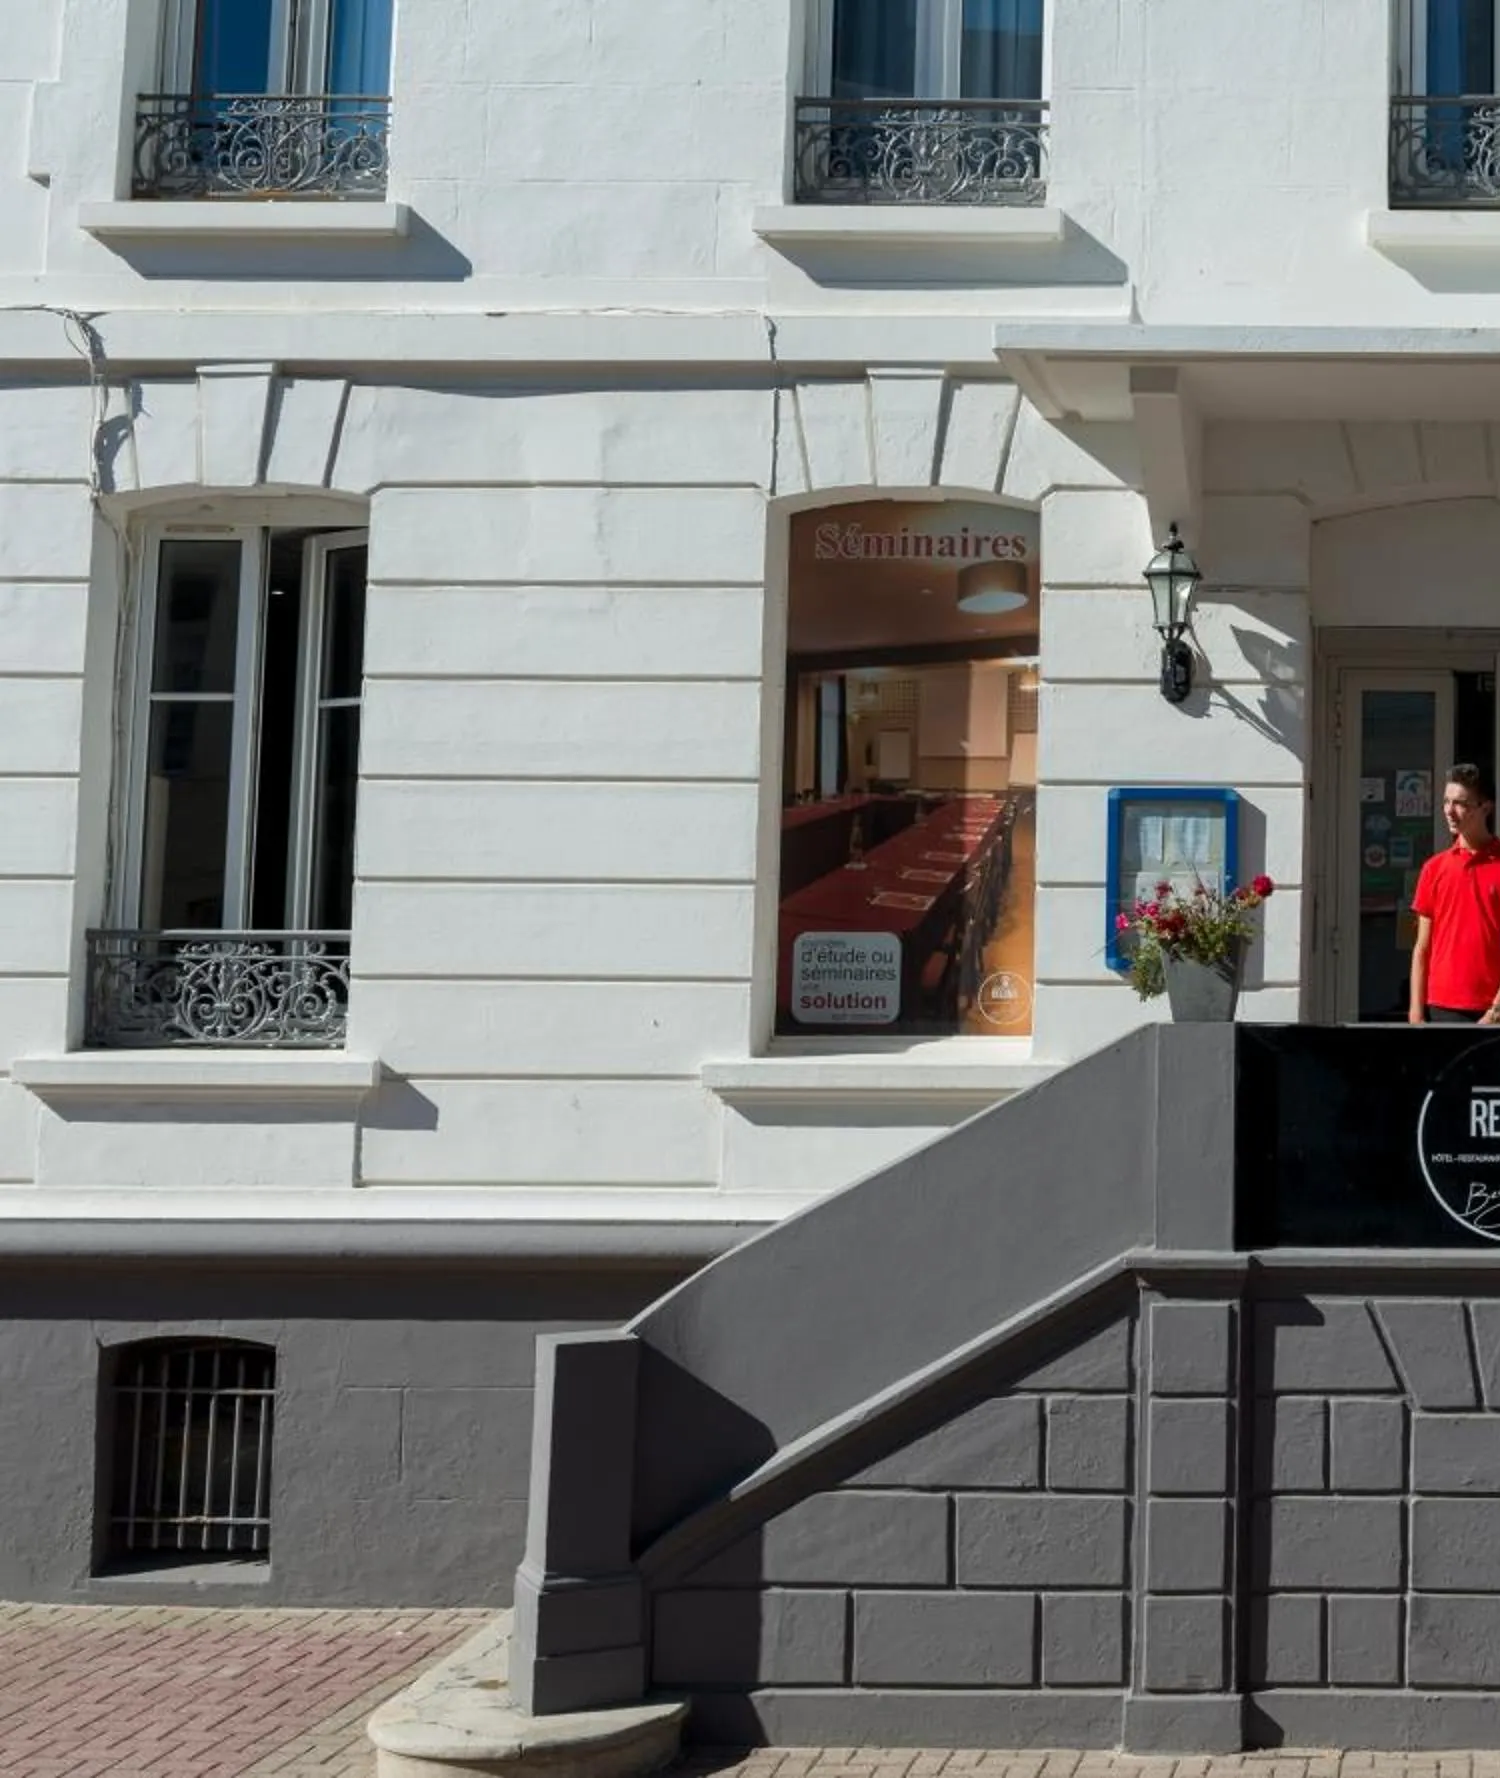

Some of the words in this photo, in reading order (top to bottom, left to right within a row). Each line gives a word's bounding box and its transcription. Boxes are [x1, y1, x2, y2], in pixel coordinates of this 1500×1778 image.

[815, 521, 1027, 559] Séminaires
[801, 946, 866, 964] d'étude
[870, 950, 894, 964] ou
[801, 963, 897, 981] séminaires
[800, 991, 887, 1010] solution
